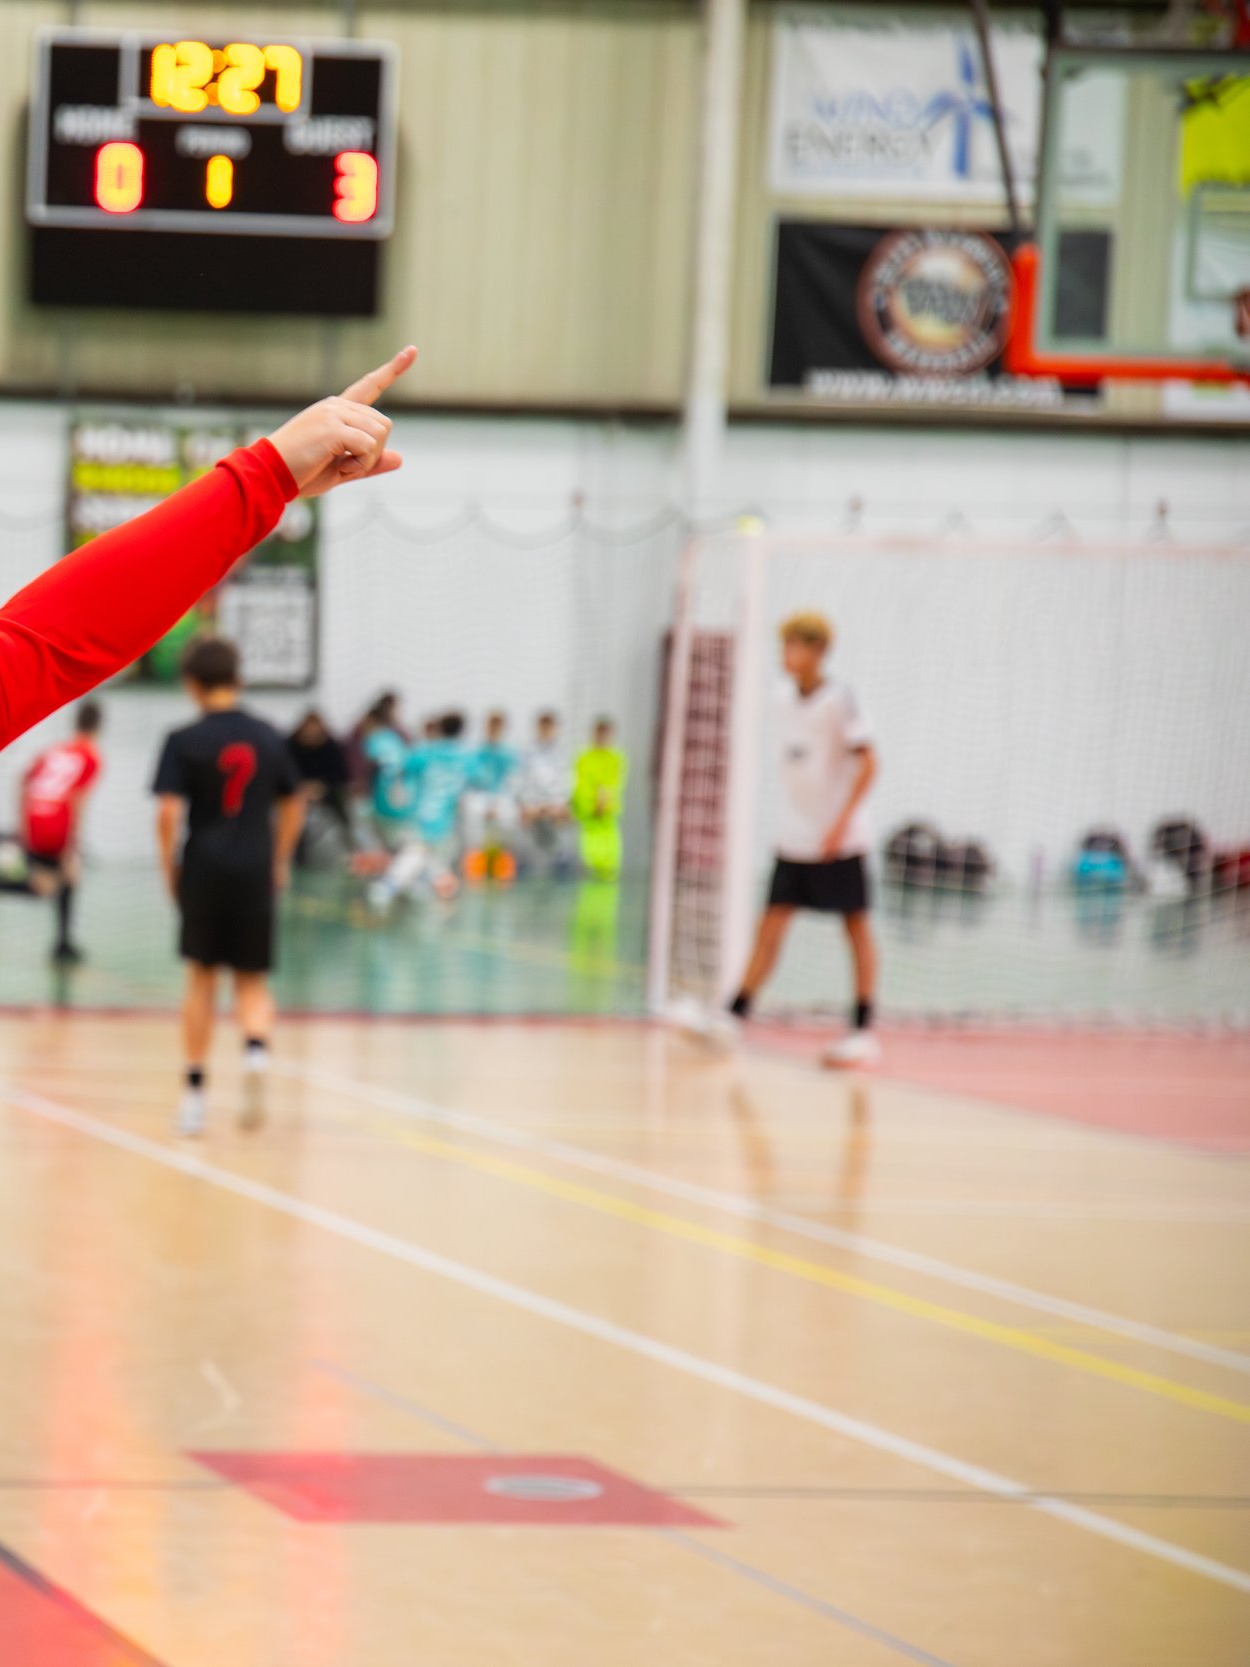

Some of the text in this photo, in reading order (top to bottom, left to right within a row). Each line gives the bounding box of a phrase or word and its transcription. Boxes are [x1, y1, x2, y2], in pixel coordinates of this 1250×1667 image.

[151, 41, 302, 114] 12:27
[94, 141, 144, 214] 0
[206, 154, 234, 209] 1
[332, 151, 379, 224] 3
